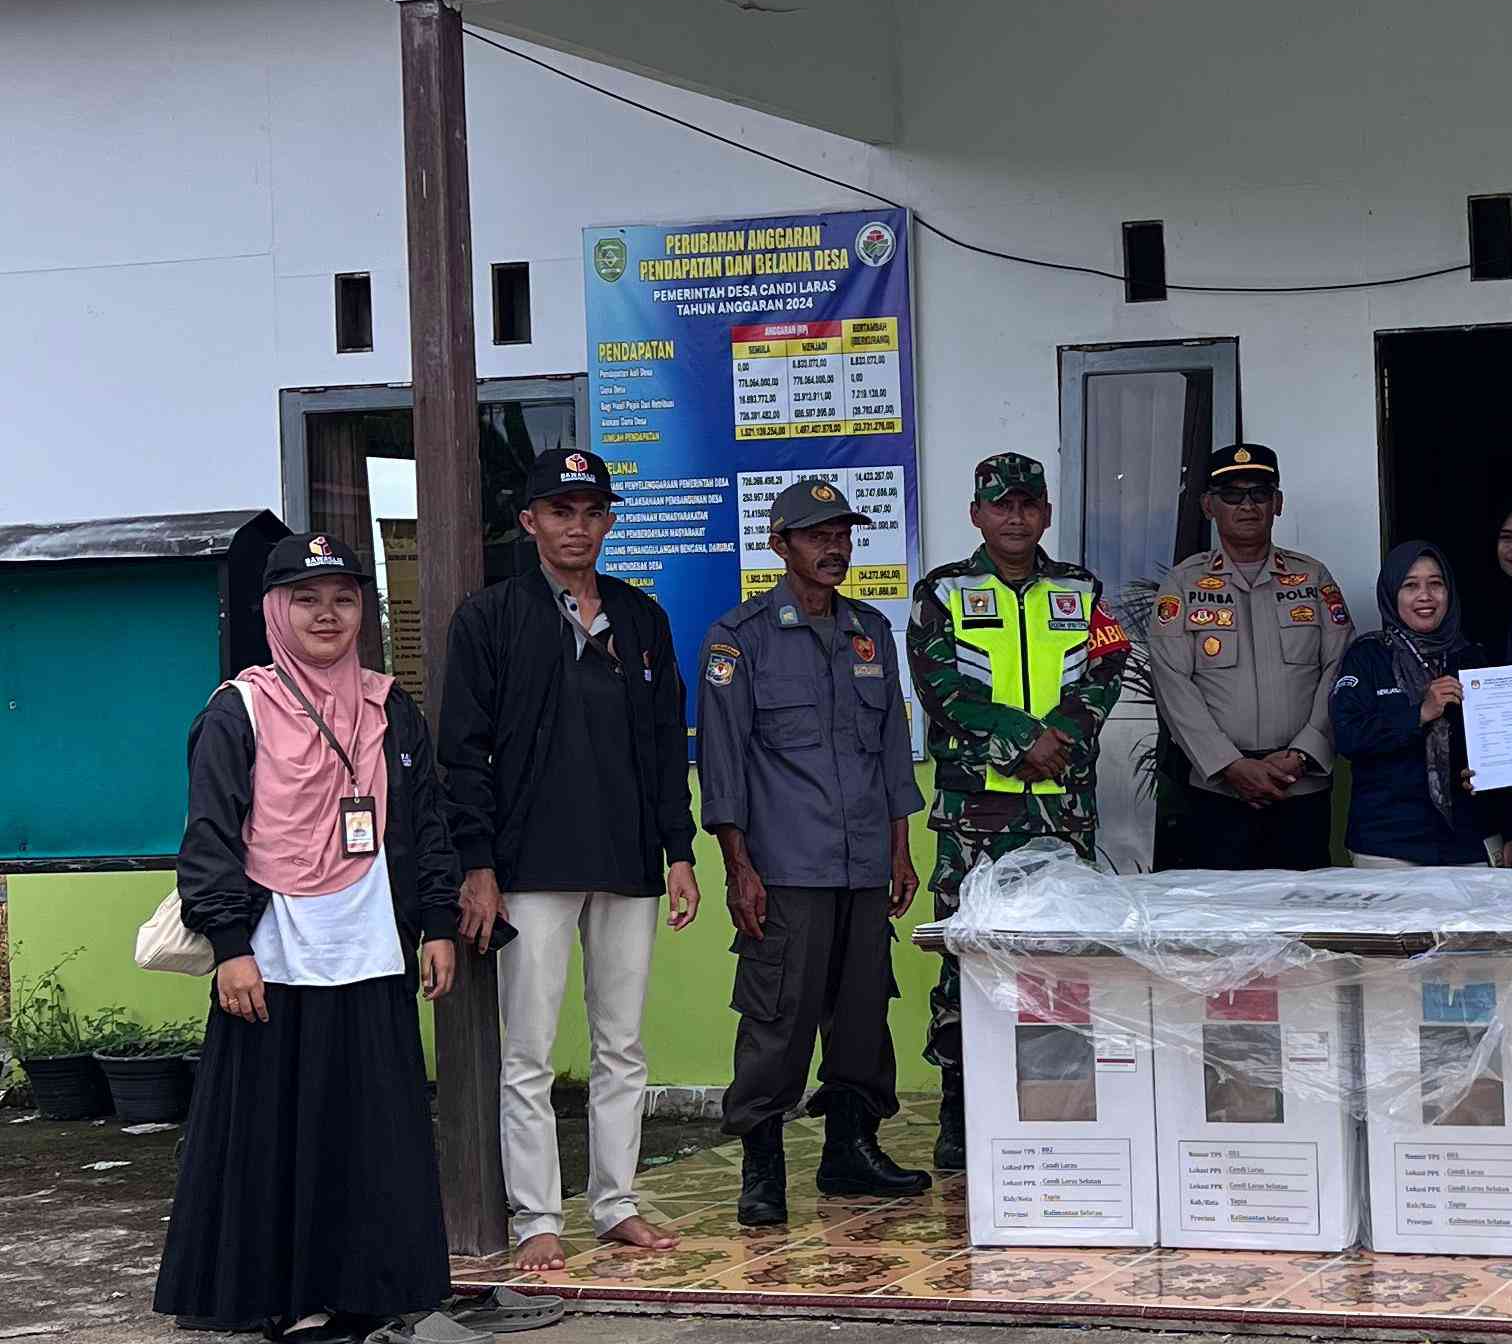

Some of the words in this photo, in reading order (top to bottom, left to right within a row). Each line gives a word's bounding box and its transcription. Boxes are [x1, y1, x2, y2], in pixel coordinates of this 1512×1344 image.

[665, 231, 745, 255] PERUBAHAN
[748, 225, 821, 250] ANGGARAN
[639, 255, 722, 281] PENDAPATAN
[724, 255, 752, 277] DAN
[755, 251, 812, 275] BELANJA
[814, 248, 849, 270] DESA
[653, 286, 725, 302] PEMERINTAH
[727, 284, 758, 298] DESA
[759, 282, 797, 295] CANDI
[799, 280, 836, 293] LARAS
[676, 303, 716, 316] TAHUN
[718, 300, 783, 314] ANGGARAN
[785, 297, 813, 310] 2024
[599, 340, 674, 362] PENDAPATAN
[1188, 590, 1234, 605] PURBA
[1275, 586, 1318, 603] POLRI
